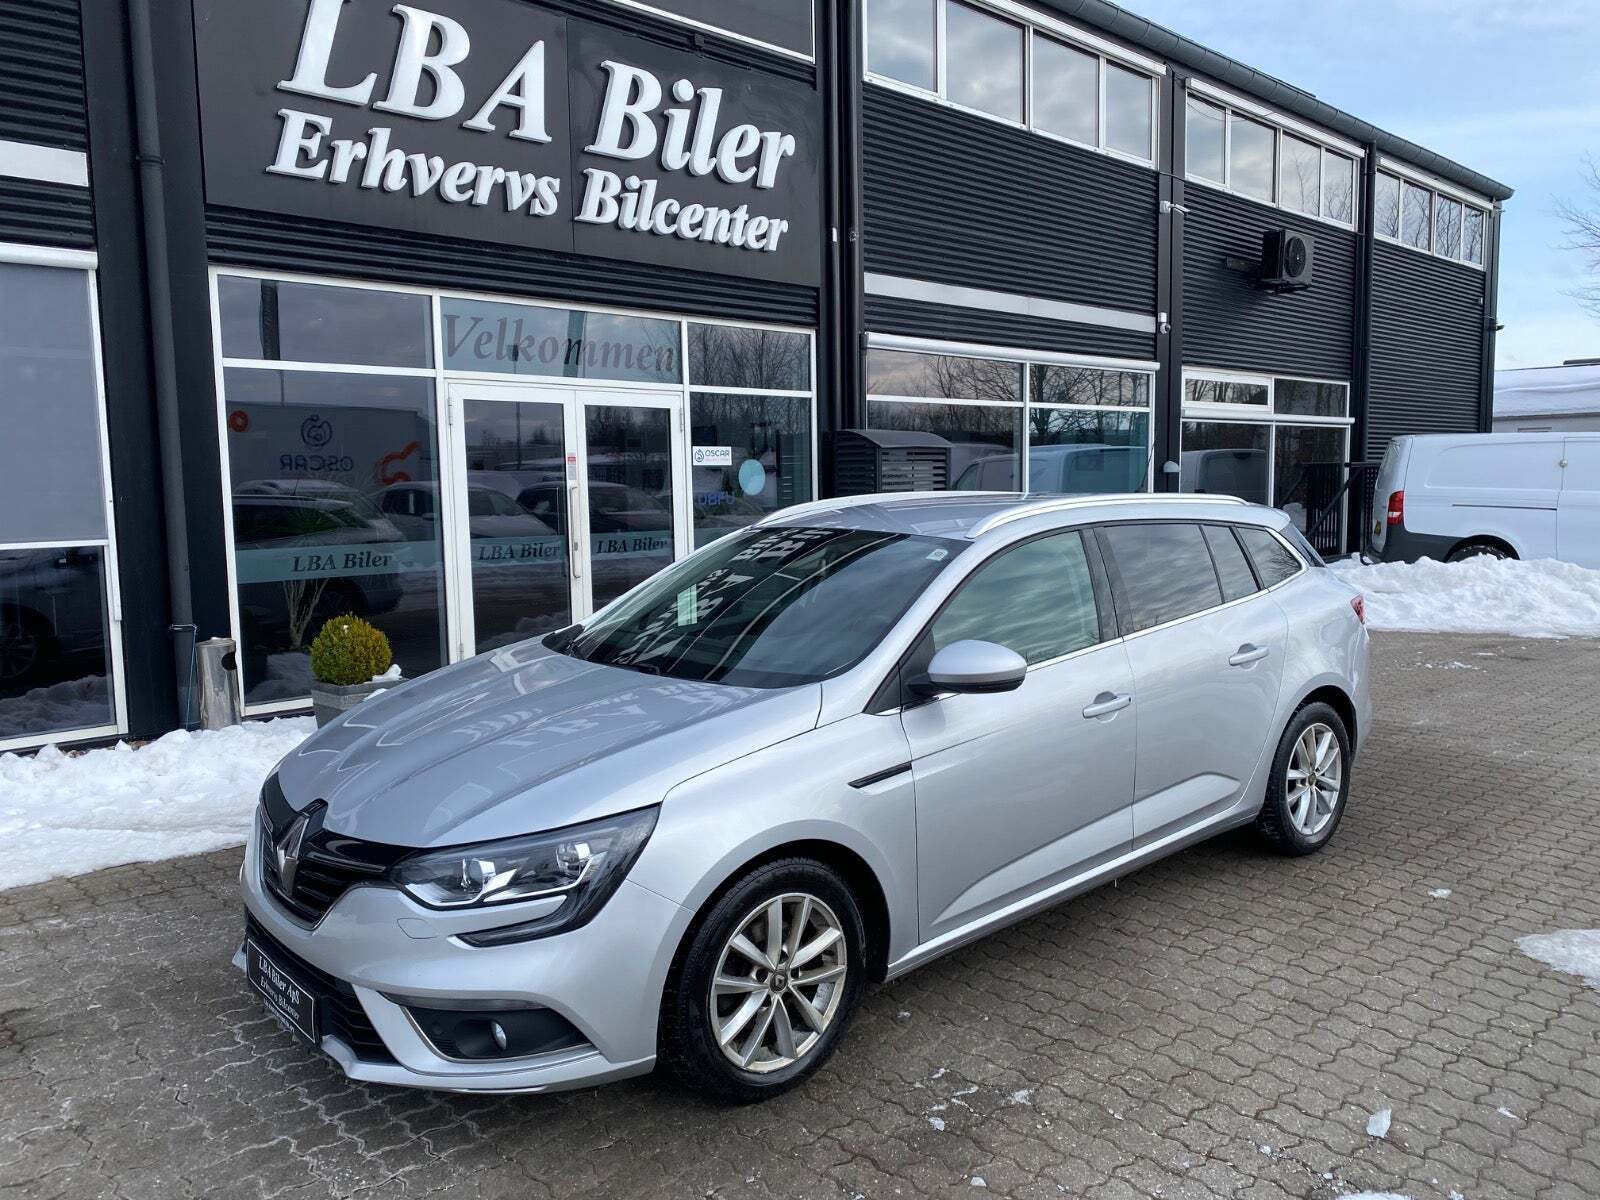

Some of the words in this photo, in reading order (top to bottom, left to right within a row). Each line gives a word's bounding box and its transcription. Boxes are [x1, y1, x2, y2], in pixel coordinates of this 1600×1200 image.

[277, 0, 553, 143] LBA
[584, 60, 795, 188] Biler
[266, 108, 560, 216] Erhvervs
[574, 167, 788, 252] Bilcenter
[443, 314, 674, 371] Velkommen
[704, 449, 730, 457] OSCAR
[478, 546, 515, 561] LBA
[520, 543, 560, 559] Biler
[596, 539, 628, 554] LBA
[632, 537, 668, 551] Biler
[292, 554, 337, 573] LBA
[343, 551, 392, 570] Biler
[271, 967, 287, 991] Biler
